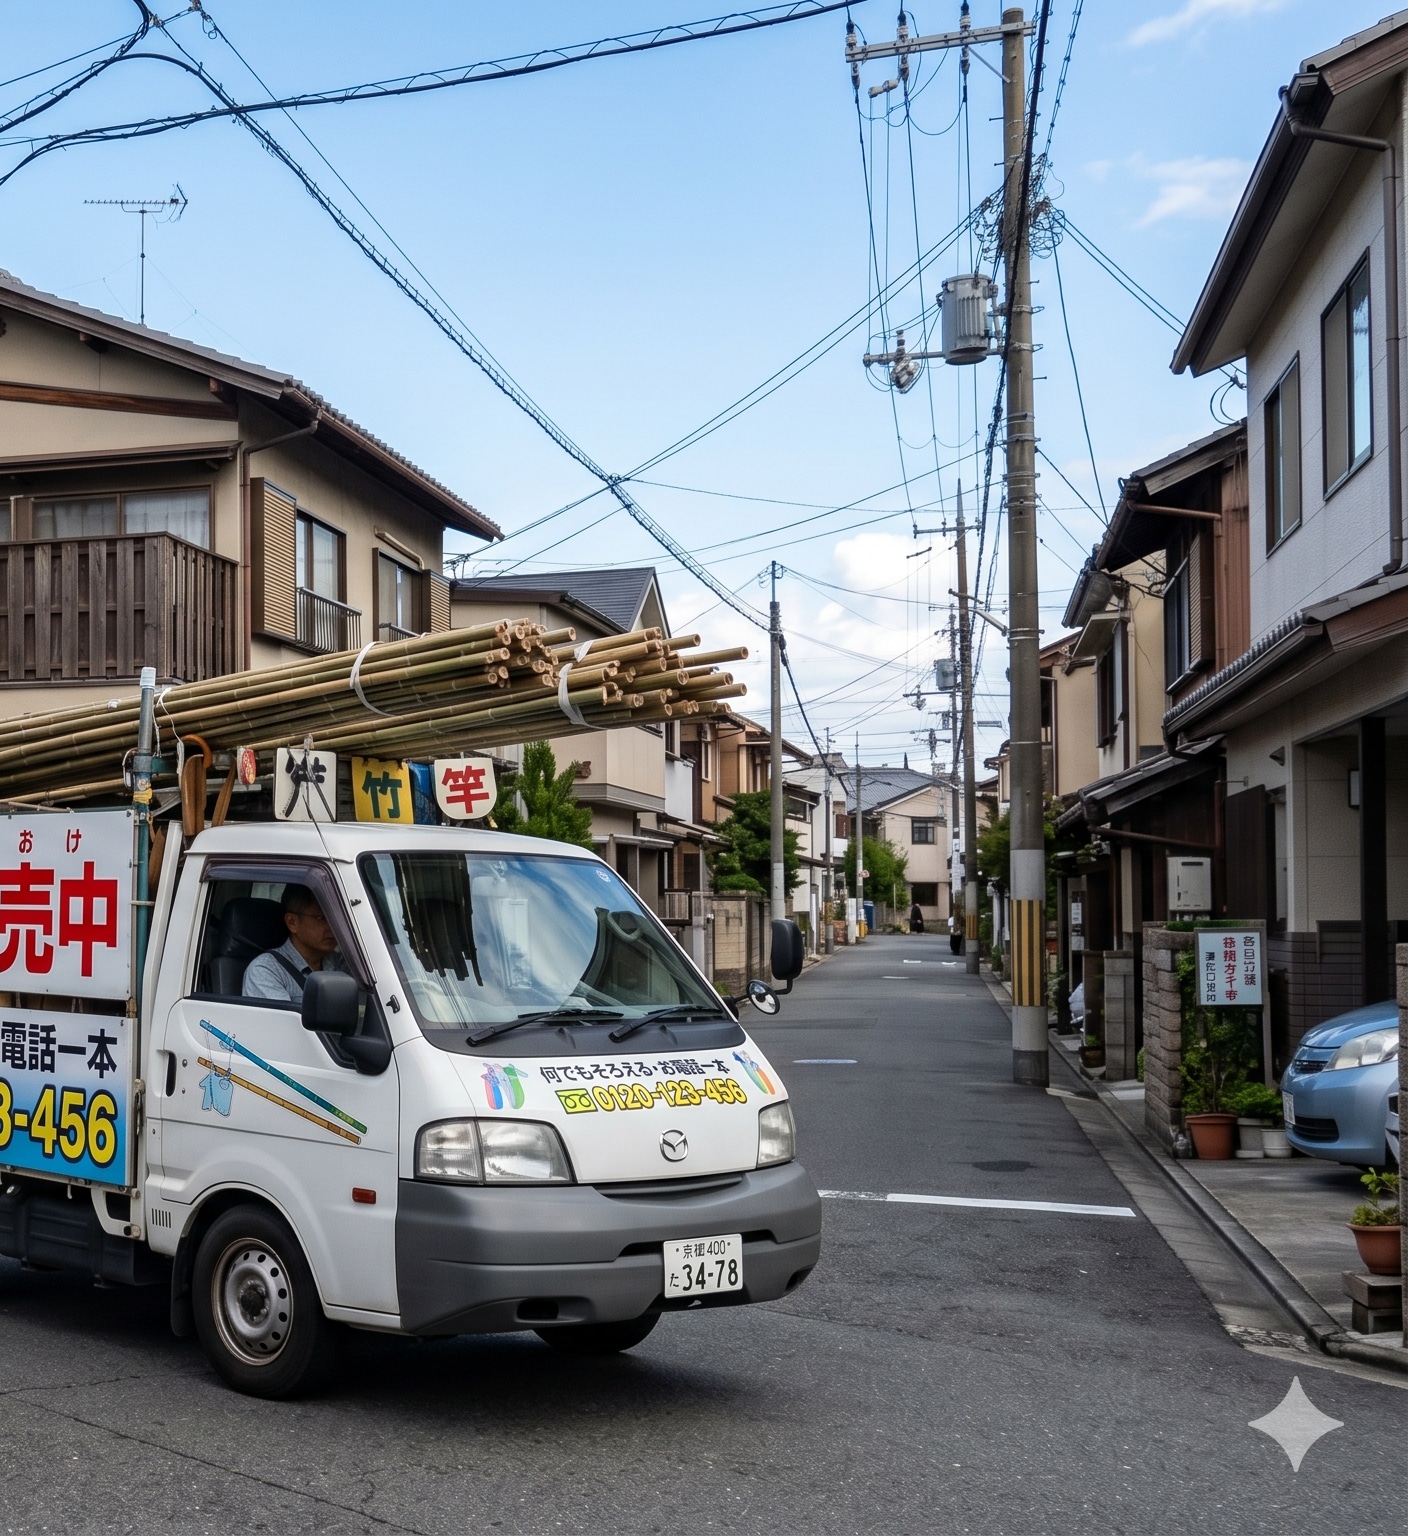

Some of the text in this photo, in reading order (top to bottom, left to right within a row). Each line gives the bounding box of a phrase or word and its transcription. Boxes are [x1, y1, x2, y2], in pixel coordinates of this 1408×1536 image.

[361, 771, 402, 818] 竹
[441, 765, 490, 814] 竿
[591, 1078, 748, 1112] 0120-123-456
[682, 1259, 738, 1291] 34-78
